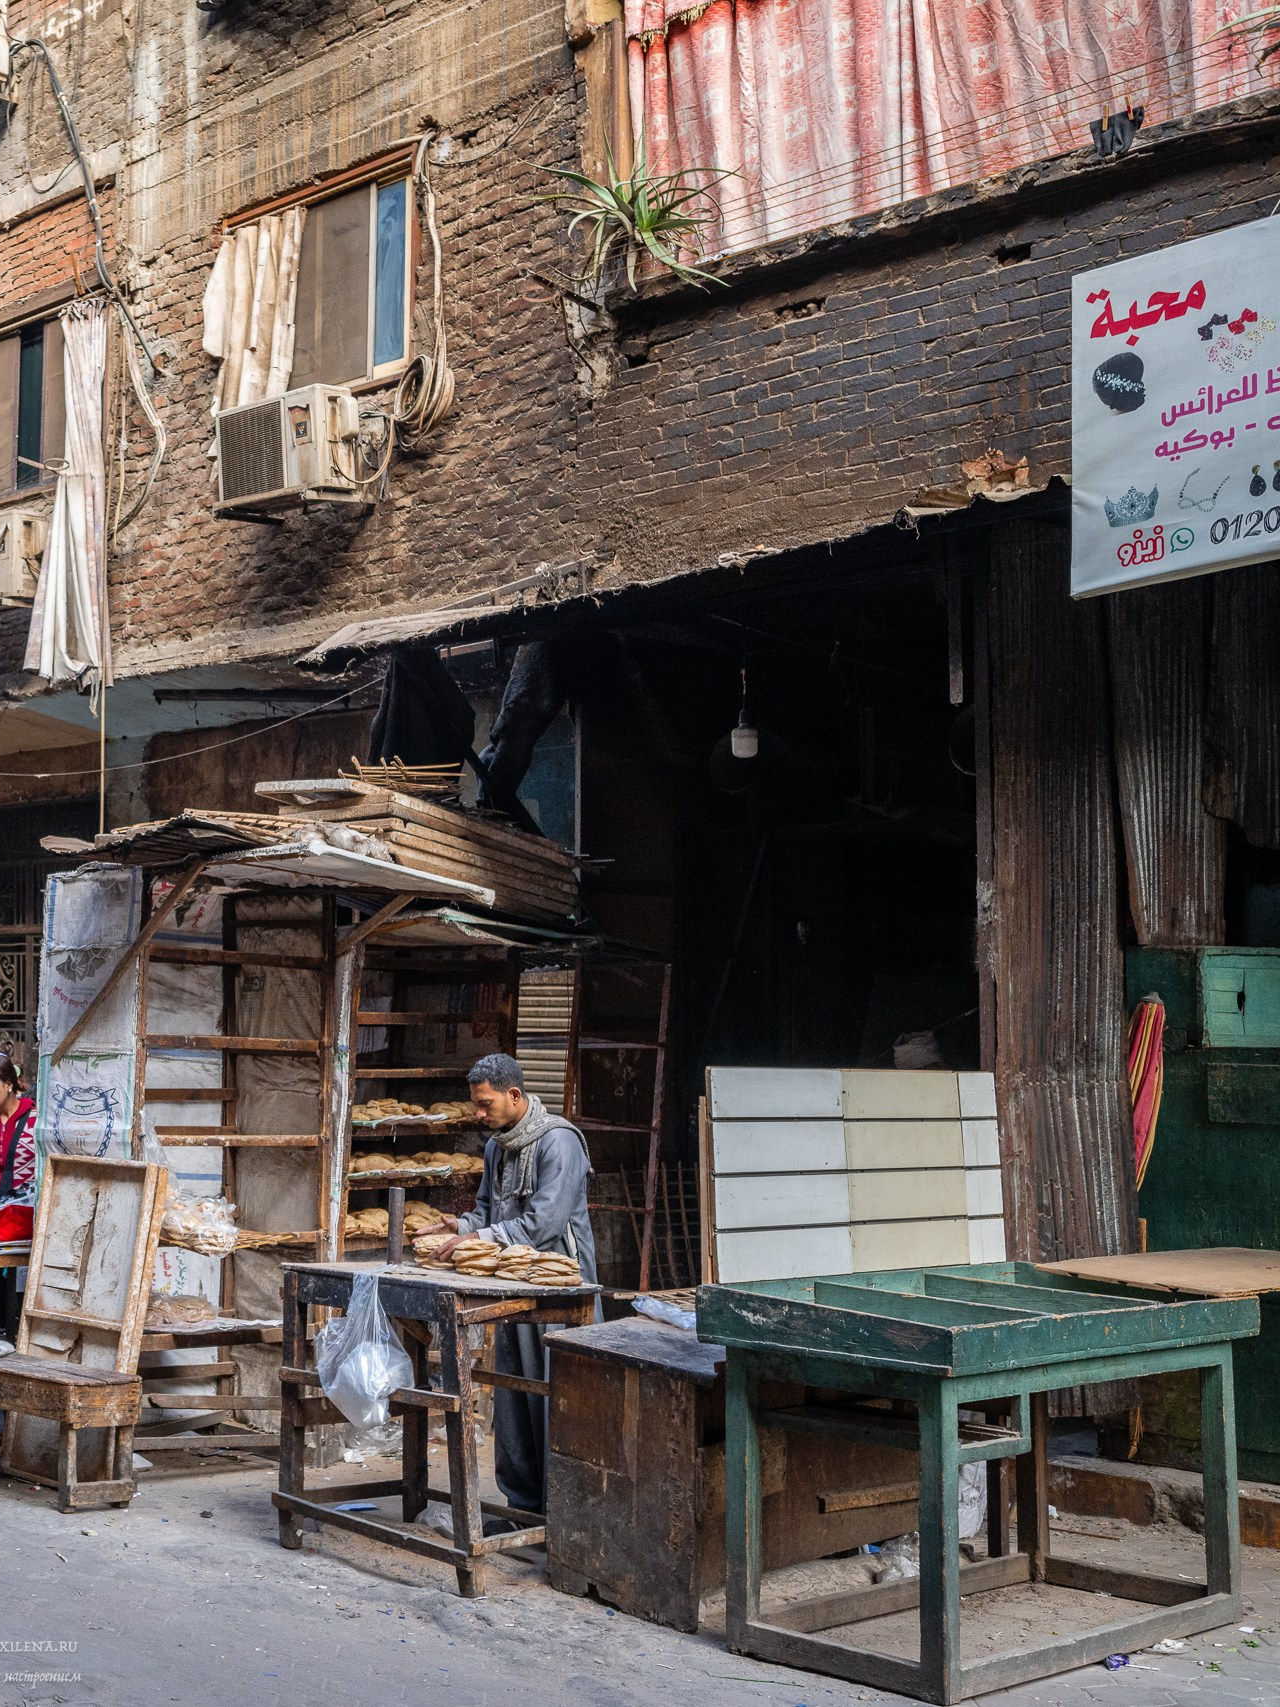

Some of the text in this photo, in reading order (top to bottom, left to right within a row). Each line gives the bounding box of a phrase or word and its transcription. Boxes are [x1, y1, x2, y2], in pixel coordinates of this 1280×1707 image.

[1086, 280, 1207, 347] محبة
[1161, 373, 1258, 427] للعرائس
[1154, 426, 1236, 462] بوكيه
[1117, 525, 1165, 567] زيزو
[1209, 505, 1280, 545] 0120
